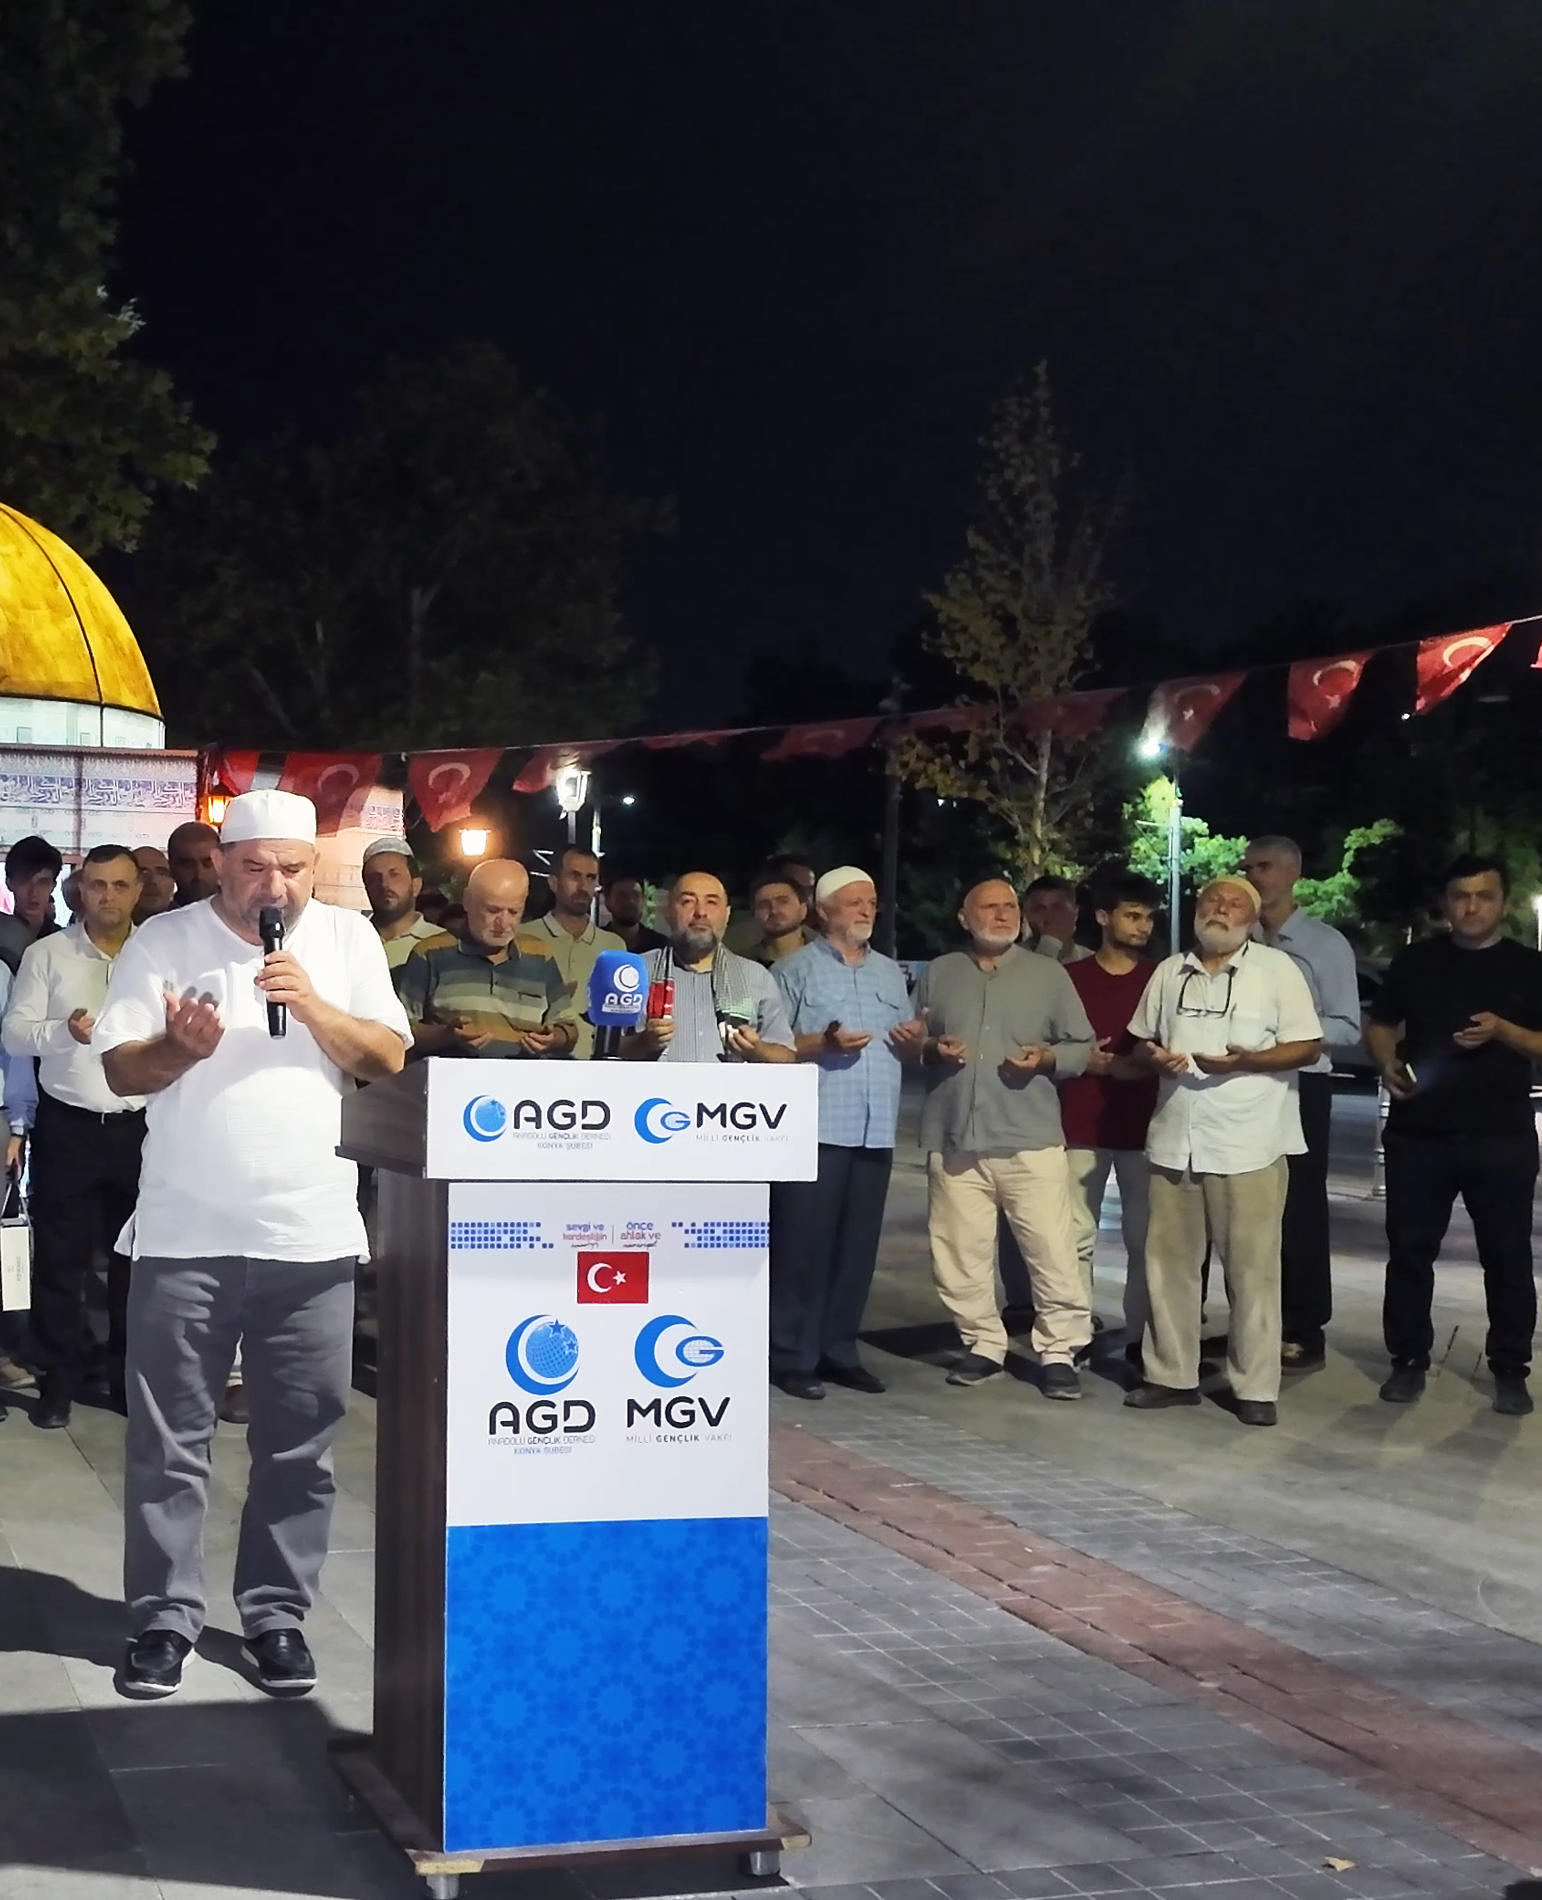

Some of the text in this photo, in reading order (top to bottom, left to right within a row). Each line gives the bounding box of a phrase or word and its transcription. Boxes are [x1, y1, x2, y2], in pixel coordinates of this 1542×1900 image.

[605, 992, 643, 1005] AGD
[514, 1099, 611, 1131] AGD
[696, 1101, 788, 1130] MGV
[626, 1221, 654, 1231] önce
[489, 1399, 596, 1435] AGD
[627, 1395, 731, 1429] MGV
